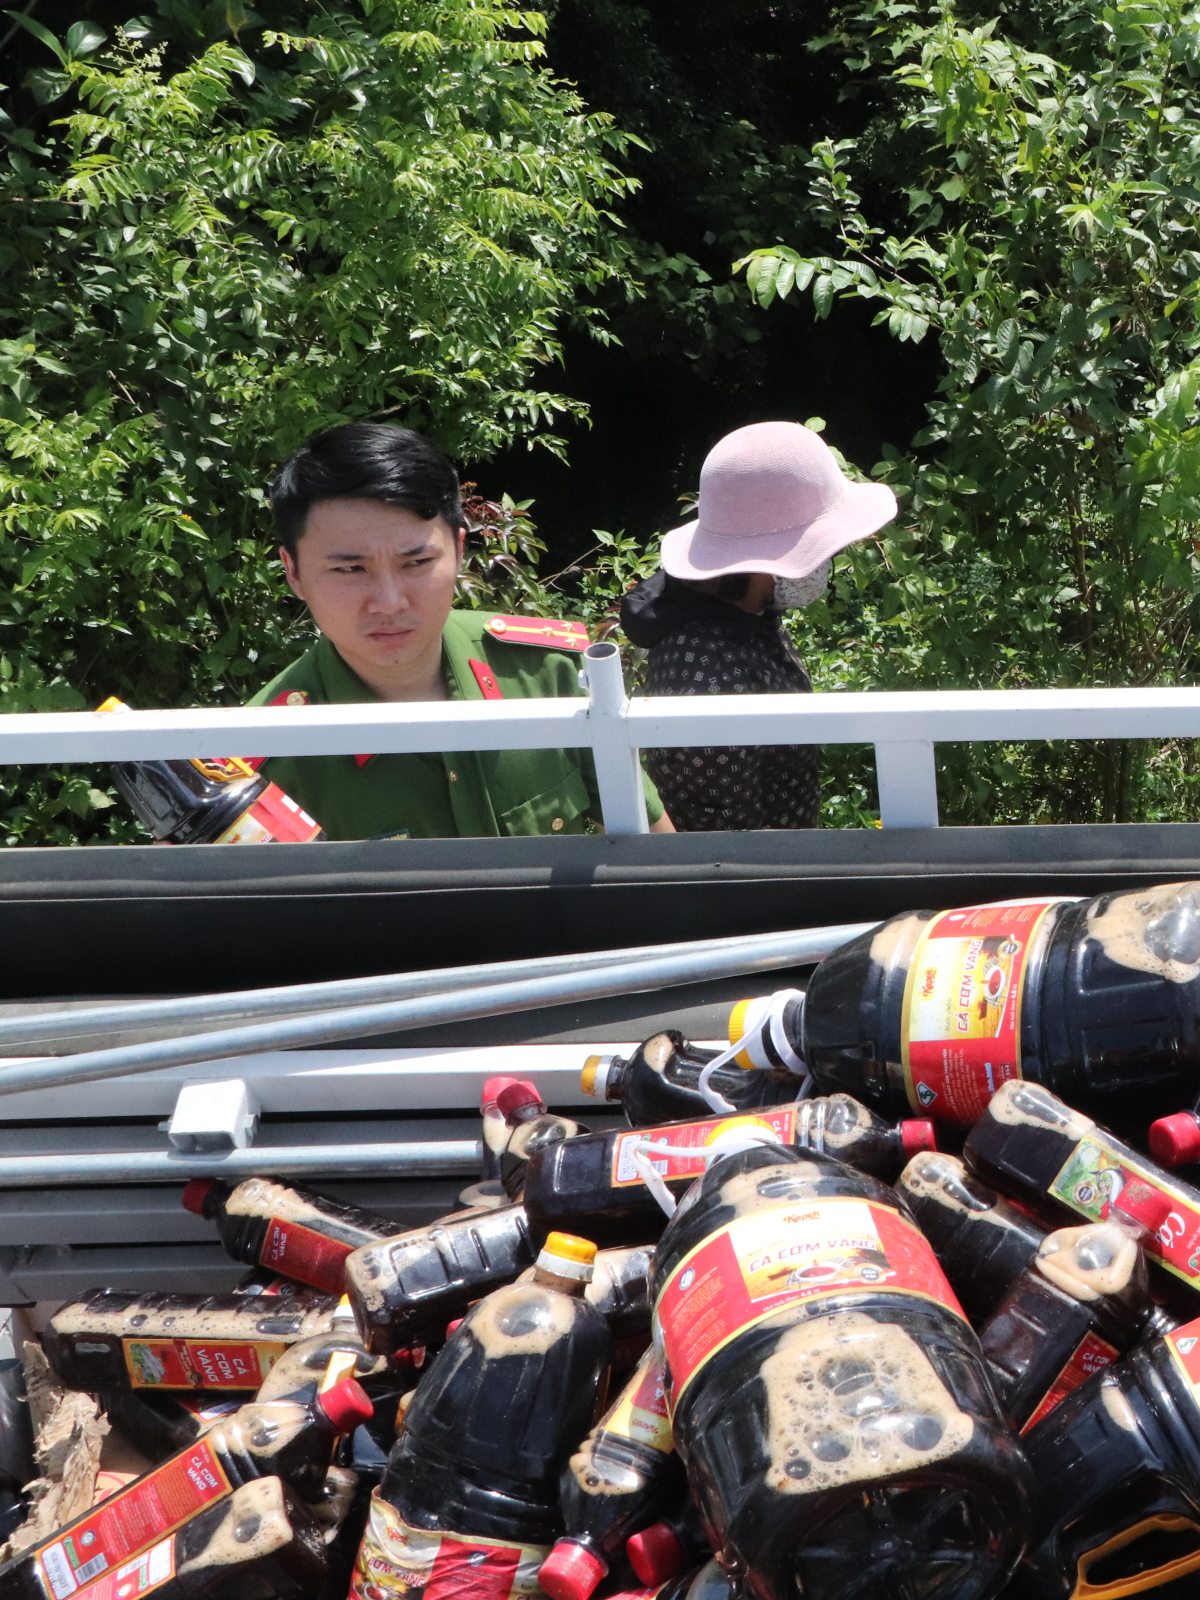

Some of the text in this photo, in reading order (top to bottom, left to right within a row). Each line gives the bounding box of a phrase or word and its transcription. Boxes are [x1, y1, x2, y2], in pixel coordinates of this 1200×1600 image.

[966, 938, 984, 974] VÀNG
[959, 974, 975, 1010] CƠM
[957, 1012, 969, 1033] CÁ
[749, 1254, 773, 1273] CÁ
[778, 1241, 821, 1261] CƠM
[196, 1348, 220, 1383] VÀNG
[213, 1352, 235, 1380] CƠM
[232, 1357, 250, 1376] CÁ
[186, 1467, 207, 1491] VÀNG
[190, 1455, 219, 1489] CÁ CƠM
